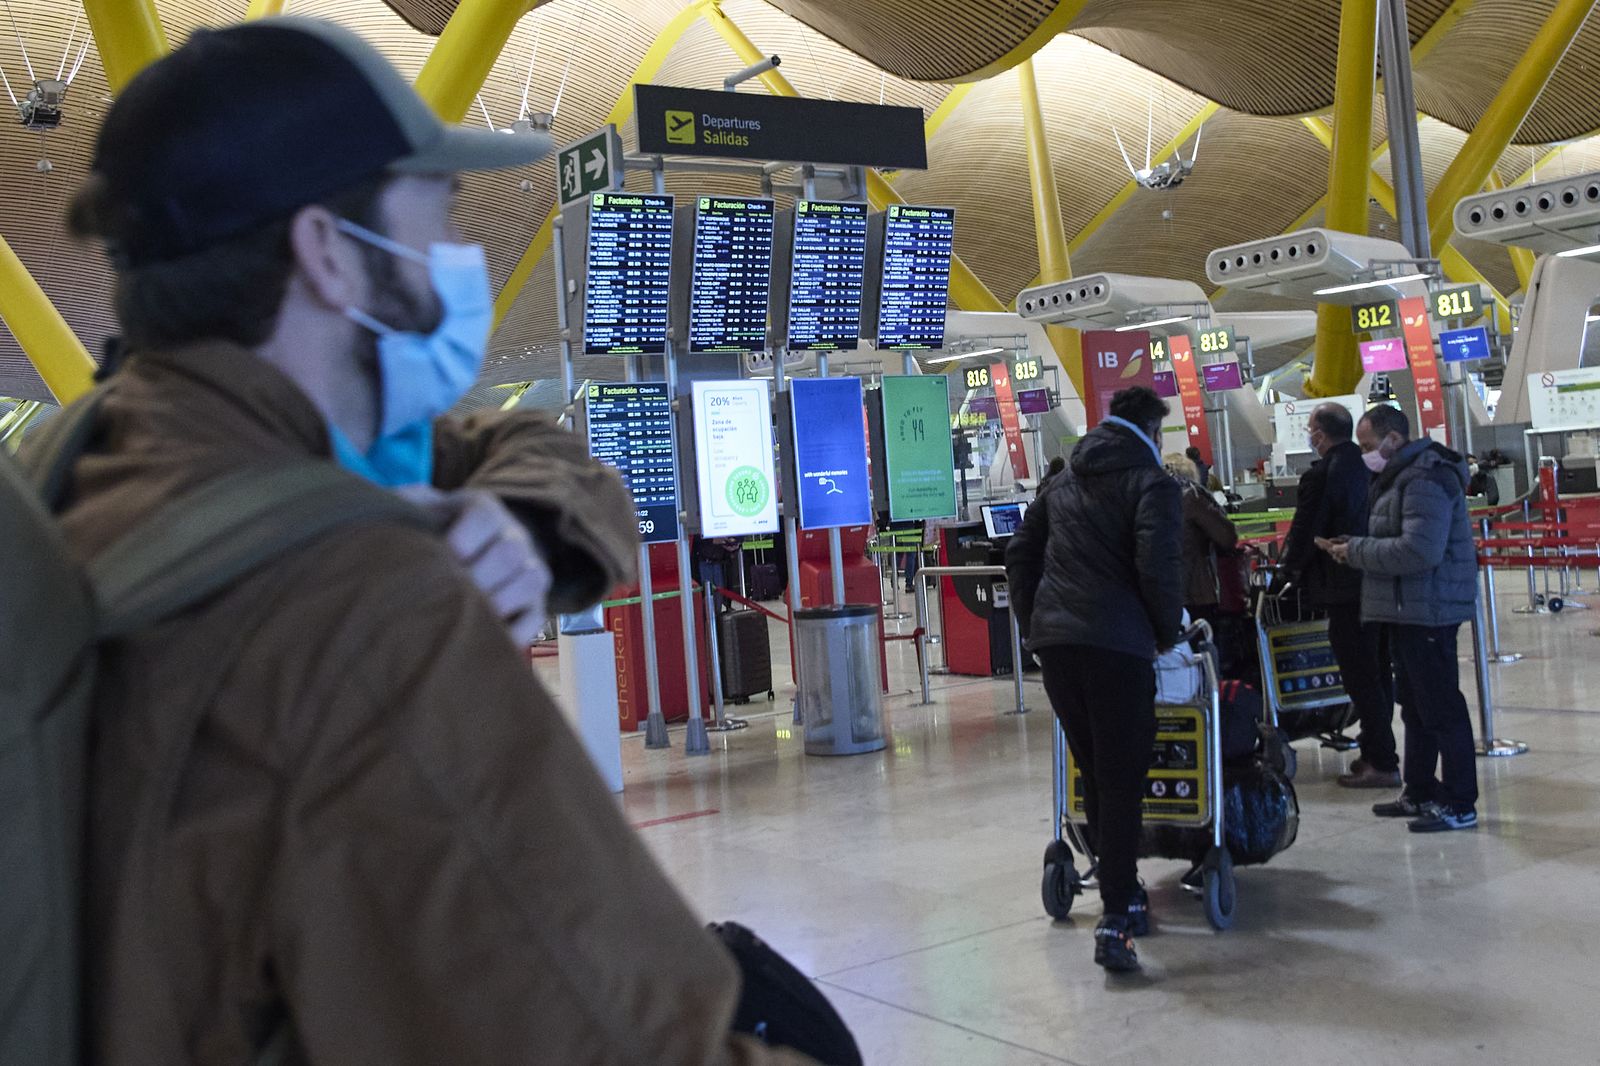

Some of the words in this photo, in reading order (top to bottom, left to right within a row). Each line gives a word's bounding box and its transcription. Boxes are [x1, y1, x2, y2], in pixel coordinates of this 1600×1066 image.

[702, 114, 761, 130] Departures
[704, 130, 748, 146] Salidas
[608, 196, 642, 205] Facturación
[714, 201, 745, 209] Facturación
[812, 204, 841, 212] Facturación
[902, 209, 929, 217] Facturación
[1438, 291, 1473, 317] 811
[1358, 305, 1392, 328] 812
[1201, 331, 1228, 352] 813
[1150, 341, 1164, 360] 14
[1098, 351, 1118, 368] IB
[967, 369, 988, 387] 816
[1015, 361, 1037, 380] 815
[710, 397, 729, 406] 20%
[639, 520, 654, 534] 59
